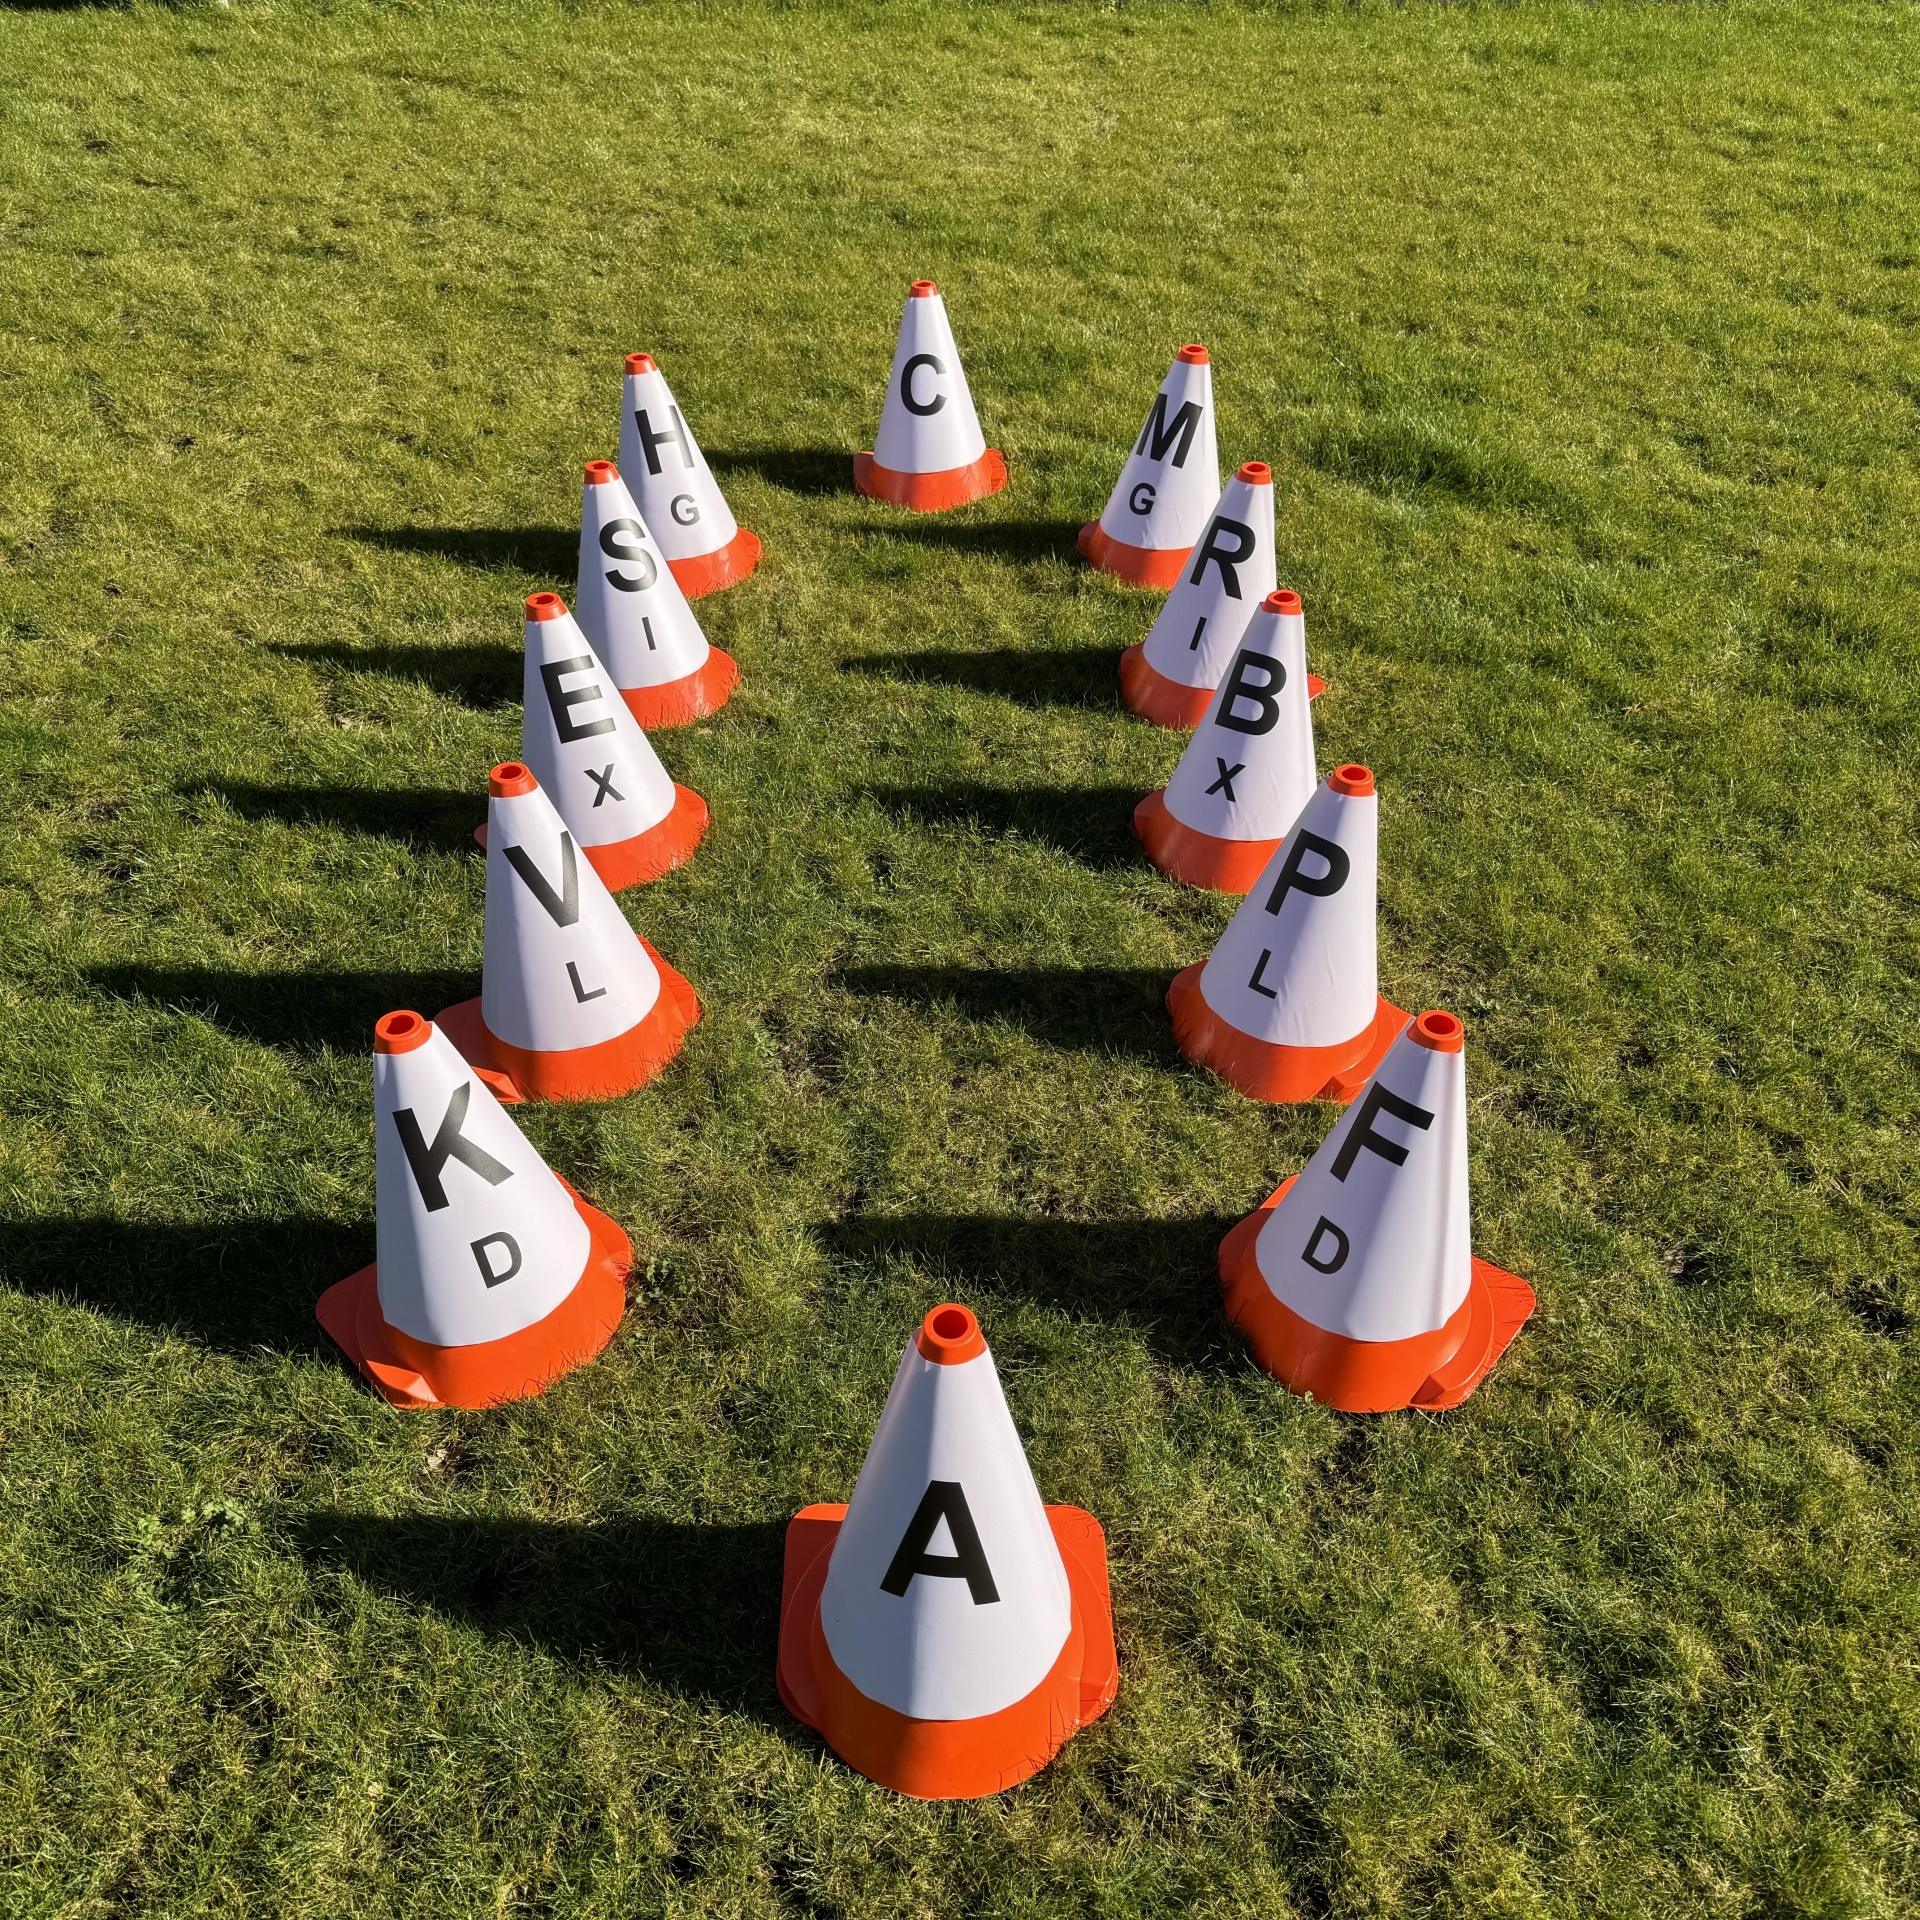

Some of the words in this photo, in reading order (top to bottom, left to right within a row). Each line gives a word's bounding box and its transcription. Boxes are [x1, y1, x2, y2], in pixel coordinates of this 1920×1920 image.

[899, 354, 947, 417] C
[635, 405, 694, 475] H
[1136, 393, 1204, 469] M
[671, 494, 699, 526] G
[1129, 483, 1156, 516] G
[598, 519, 658, 593] S
[1189, 515, 1256, 600] R
[642, 617, 657, 651] I
[1190, 616, 1208, 651] I
[540, 655, 617, 745] E
[1215, 649, 1287, 736] B
[583, 764, 626, 809] X
[1205, 758, 1246, 803] X
[503, 831, 579, 928] V
[1265, 828, 1350, 917] P
[566, 961, 607, 1004] L
[1248, 948, 1278, 1000] L
[392, 1081, 514, 1213] K
[1329, 1081, 1435, 1183] F
[470, 1231, 523, 1289] D
[1301, 1215, 1350, 1275] D
[879, 1480, 1001, 1606] A
